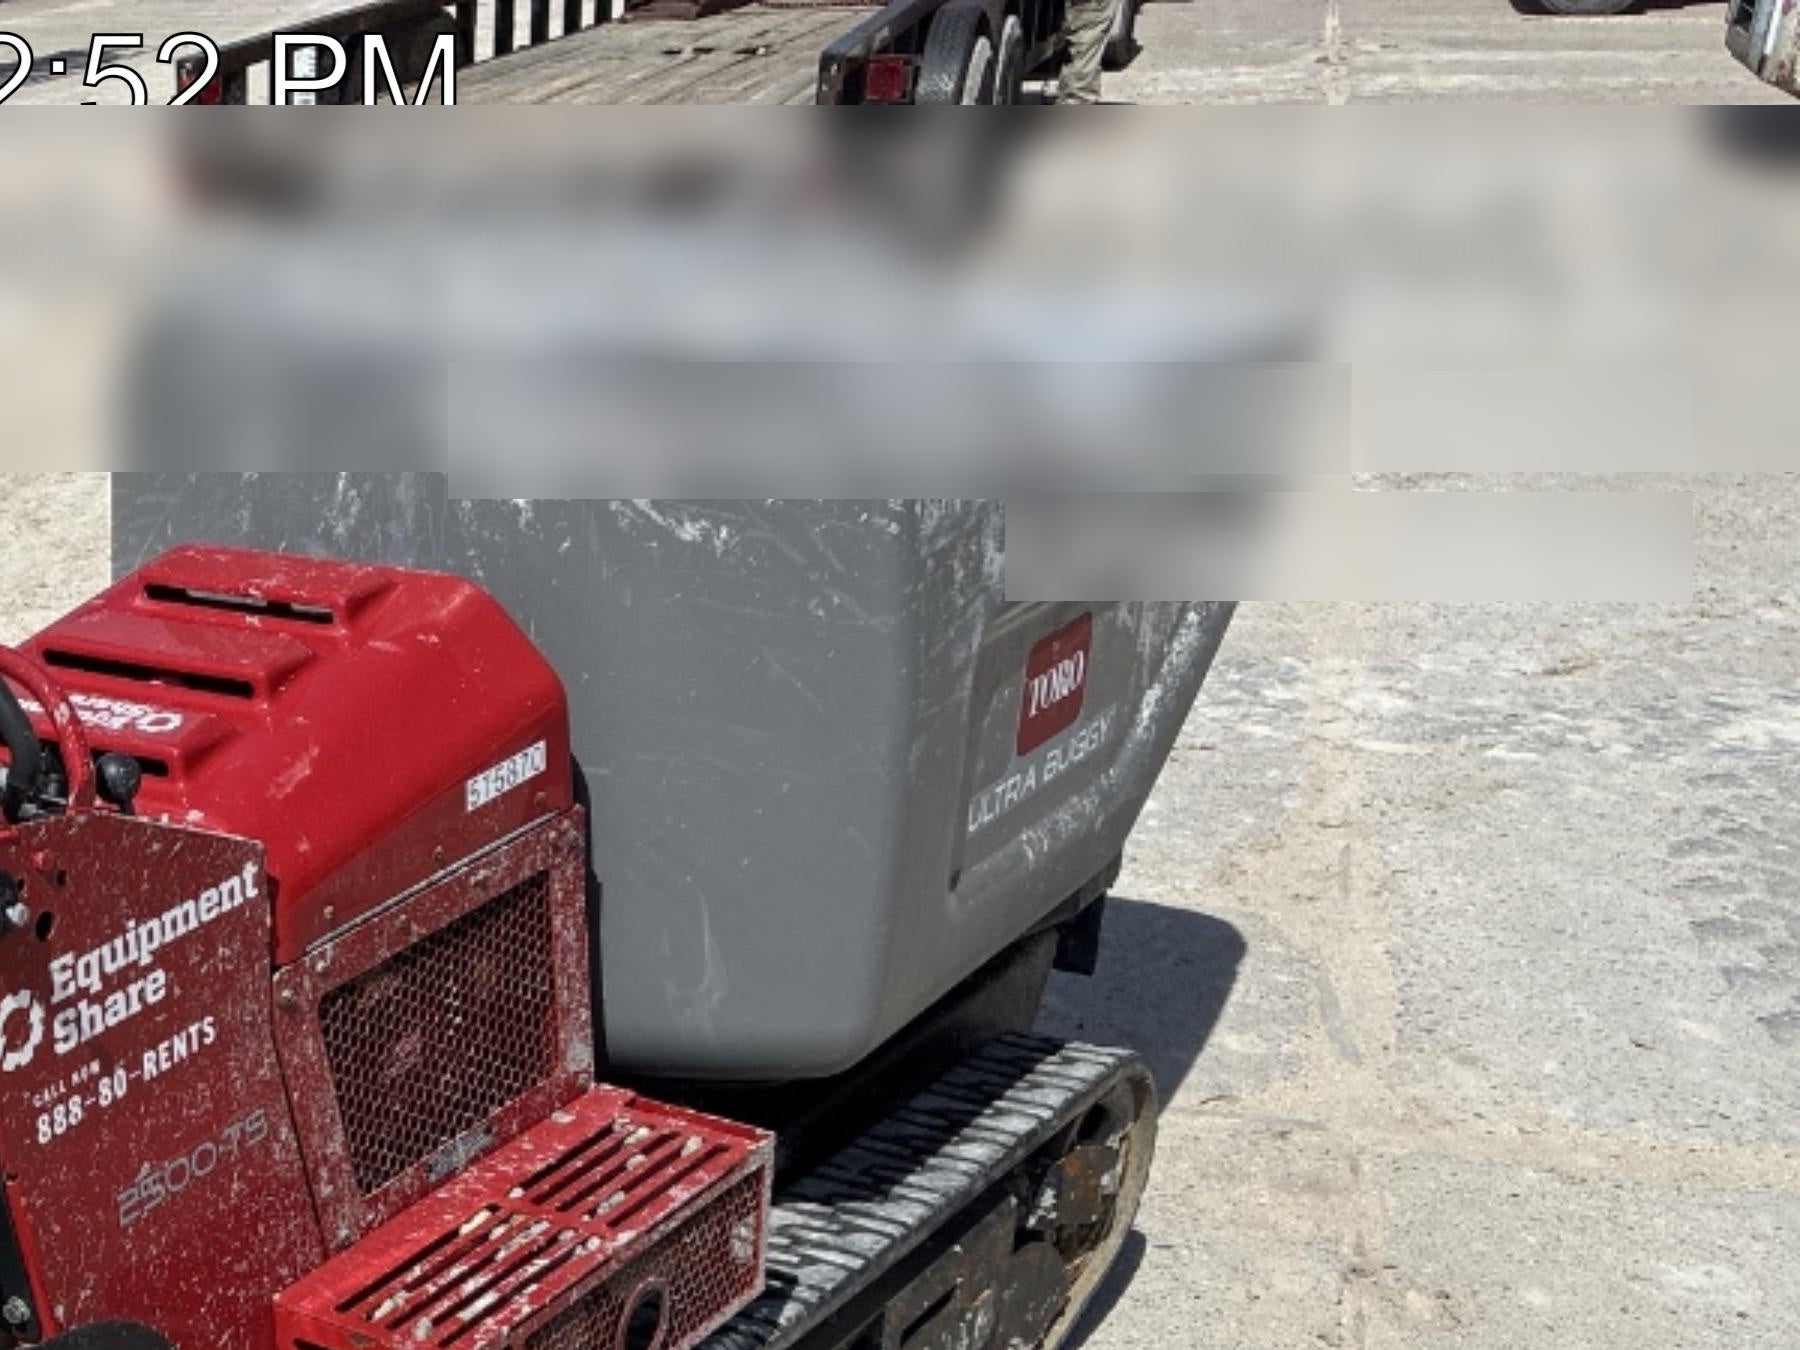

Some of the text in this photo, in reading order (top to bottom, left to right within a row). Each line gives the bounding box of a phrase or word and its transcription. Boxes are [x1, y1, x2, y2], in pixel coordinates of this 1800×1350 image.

[1028, 650, 1084, 718] TORO
[968, 702, 1117, 832] ULTRA BUGGY
[48, 861, 260, 1004] Equipment
[52, 968, 166, 1055] Share
[36, 1016, 216, 1144] 888-80-RENTS
